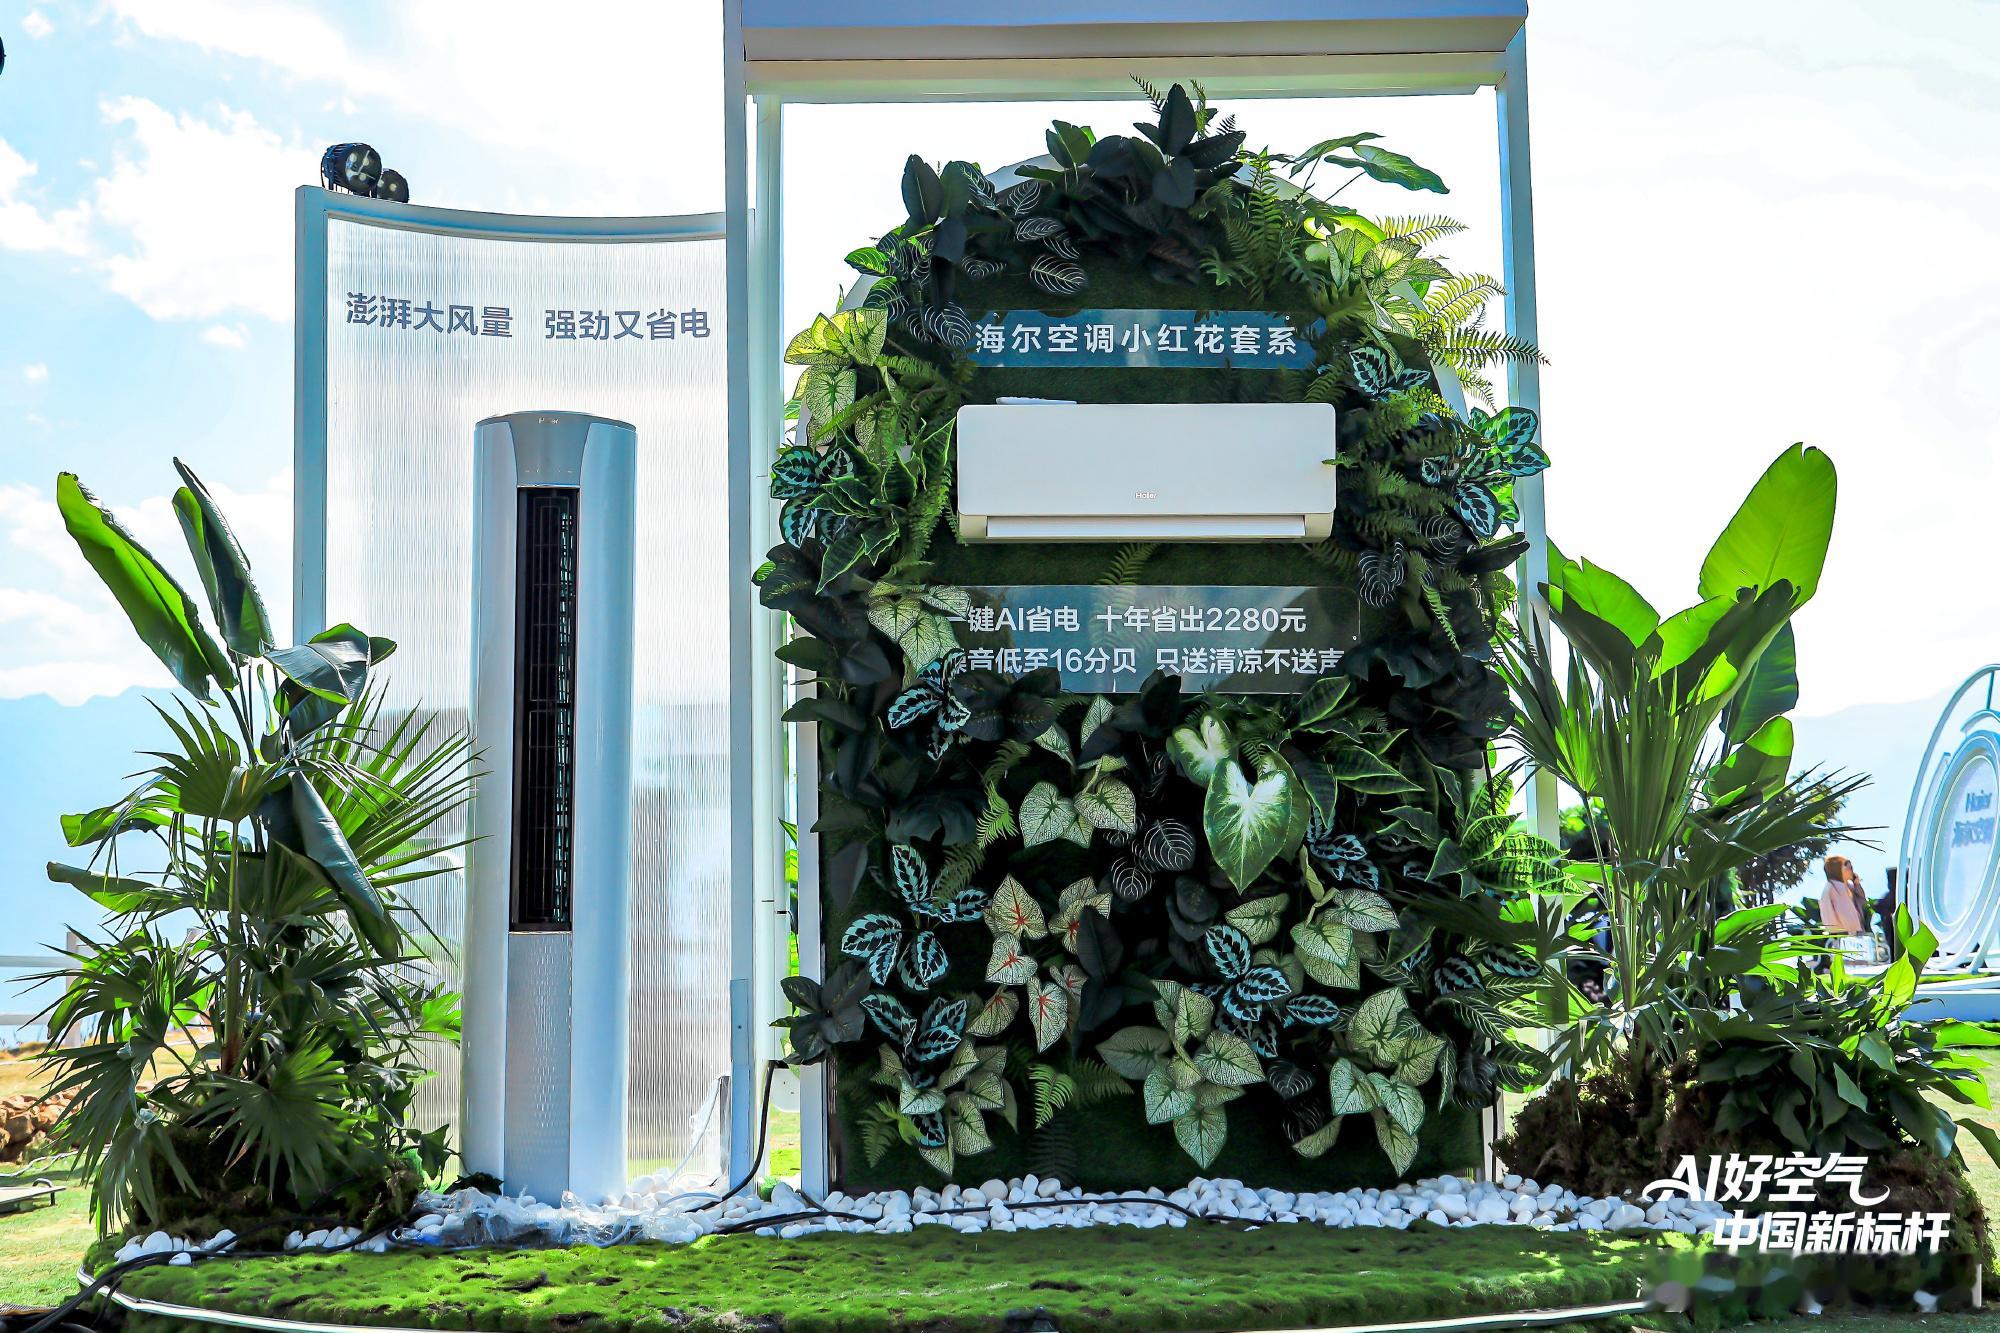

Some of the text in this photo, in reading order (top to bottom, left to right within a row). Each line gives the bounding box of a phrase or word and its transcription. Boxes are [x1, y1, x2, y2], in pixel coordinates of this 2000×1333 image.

[345, 291, 711, 341] 澎湃大风量 强劲又省电
[975, 323, 1297, 355] 海尔空调小红花套系
[1096, 605, 1307, 633] 十年省出2280元
[1156, 648, 1345, 675] 只送清凉不送声
